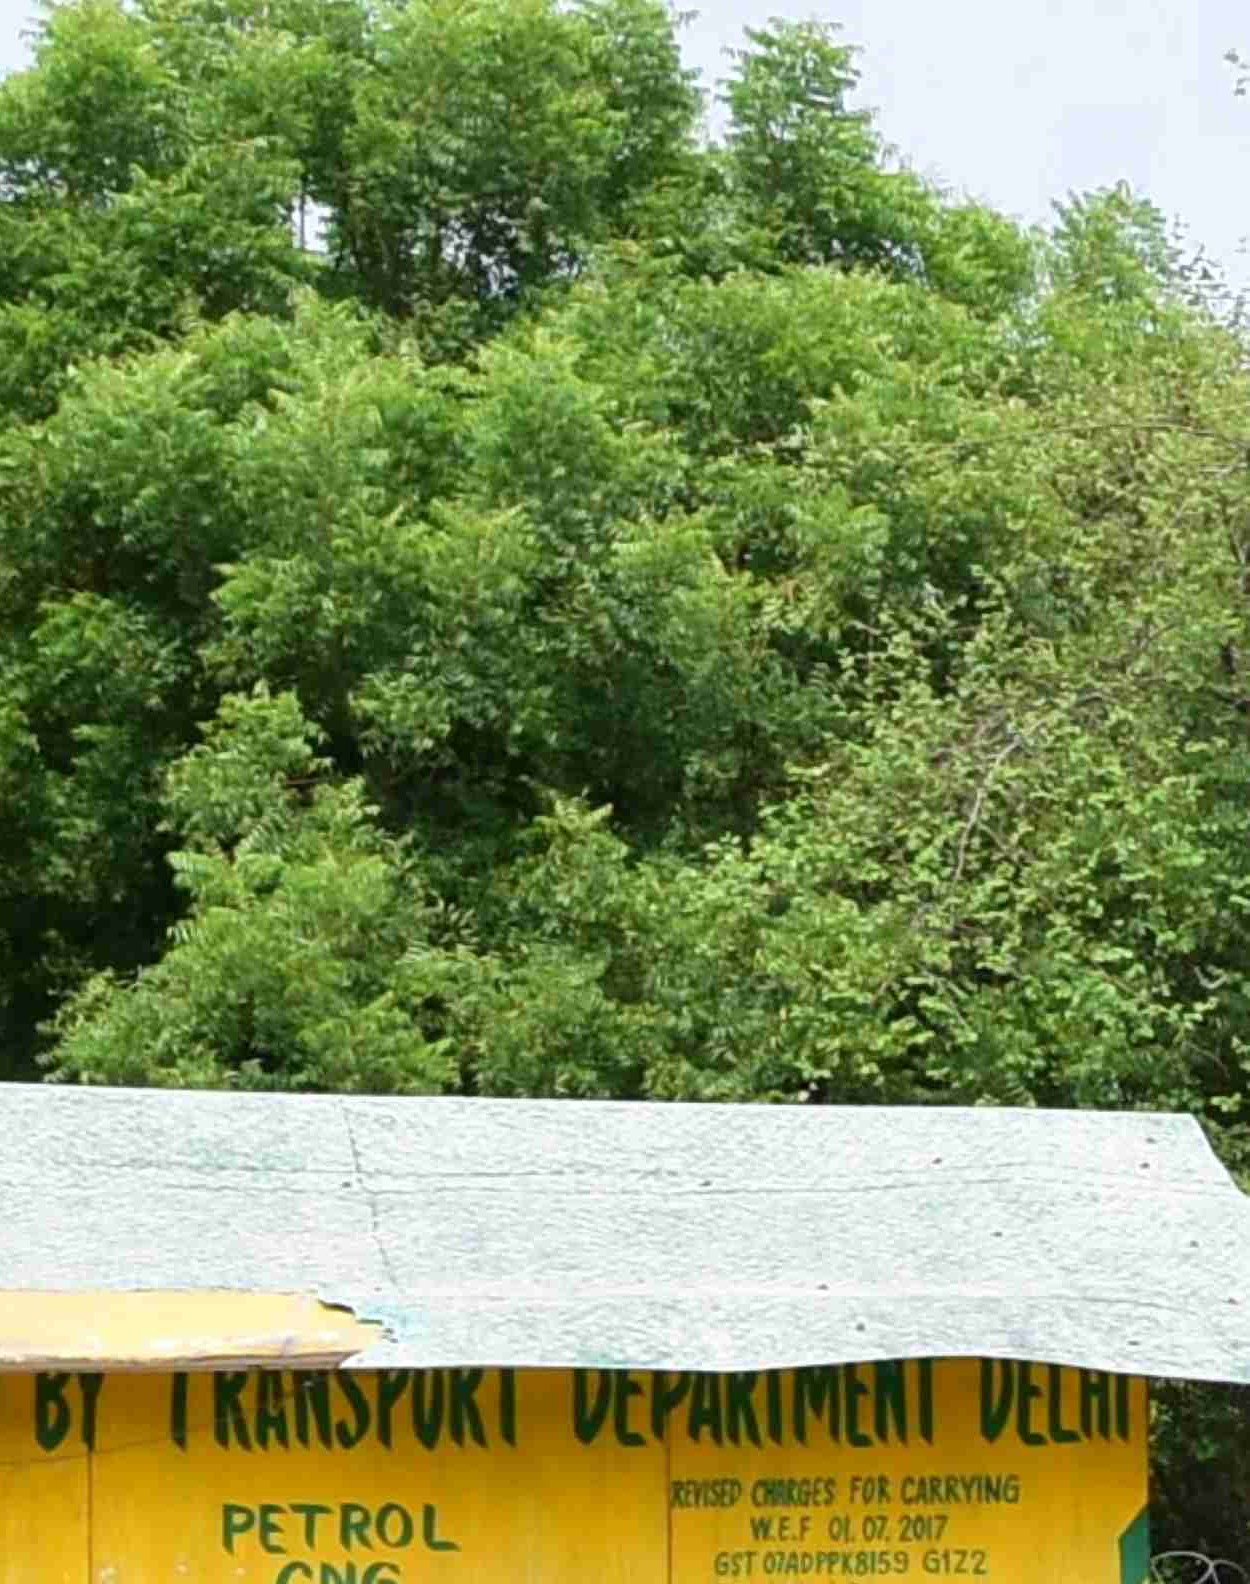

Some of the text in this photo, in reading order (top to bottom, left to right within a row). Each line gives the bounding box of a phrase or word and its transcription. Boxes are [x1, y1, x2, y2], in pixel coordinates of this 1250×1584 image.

[35, 1369, 108, 1454] BY
[751, 1477, 836, 1507] CHARGES
[850, 1475, 891, 1506] FOR
[901, 1473, 1022, 1504] CARRYING
[223, 1503, 461, 1553] PETROL
[715, 1551, 758, 1576] GST
